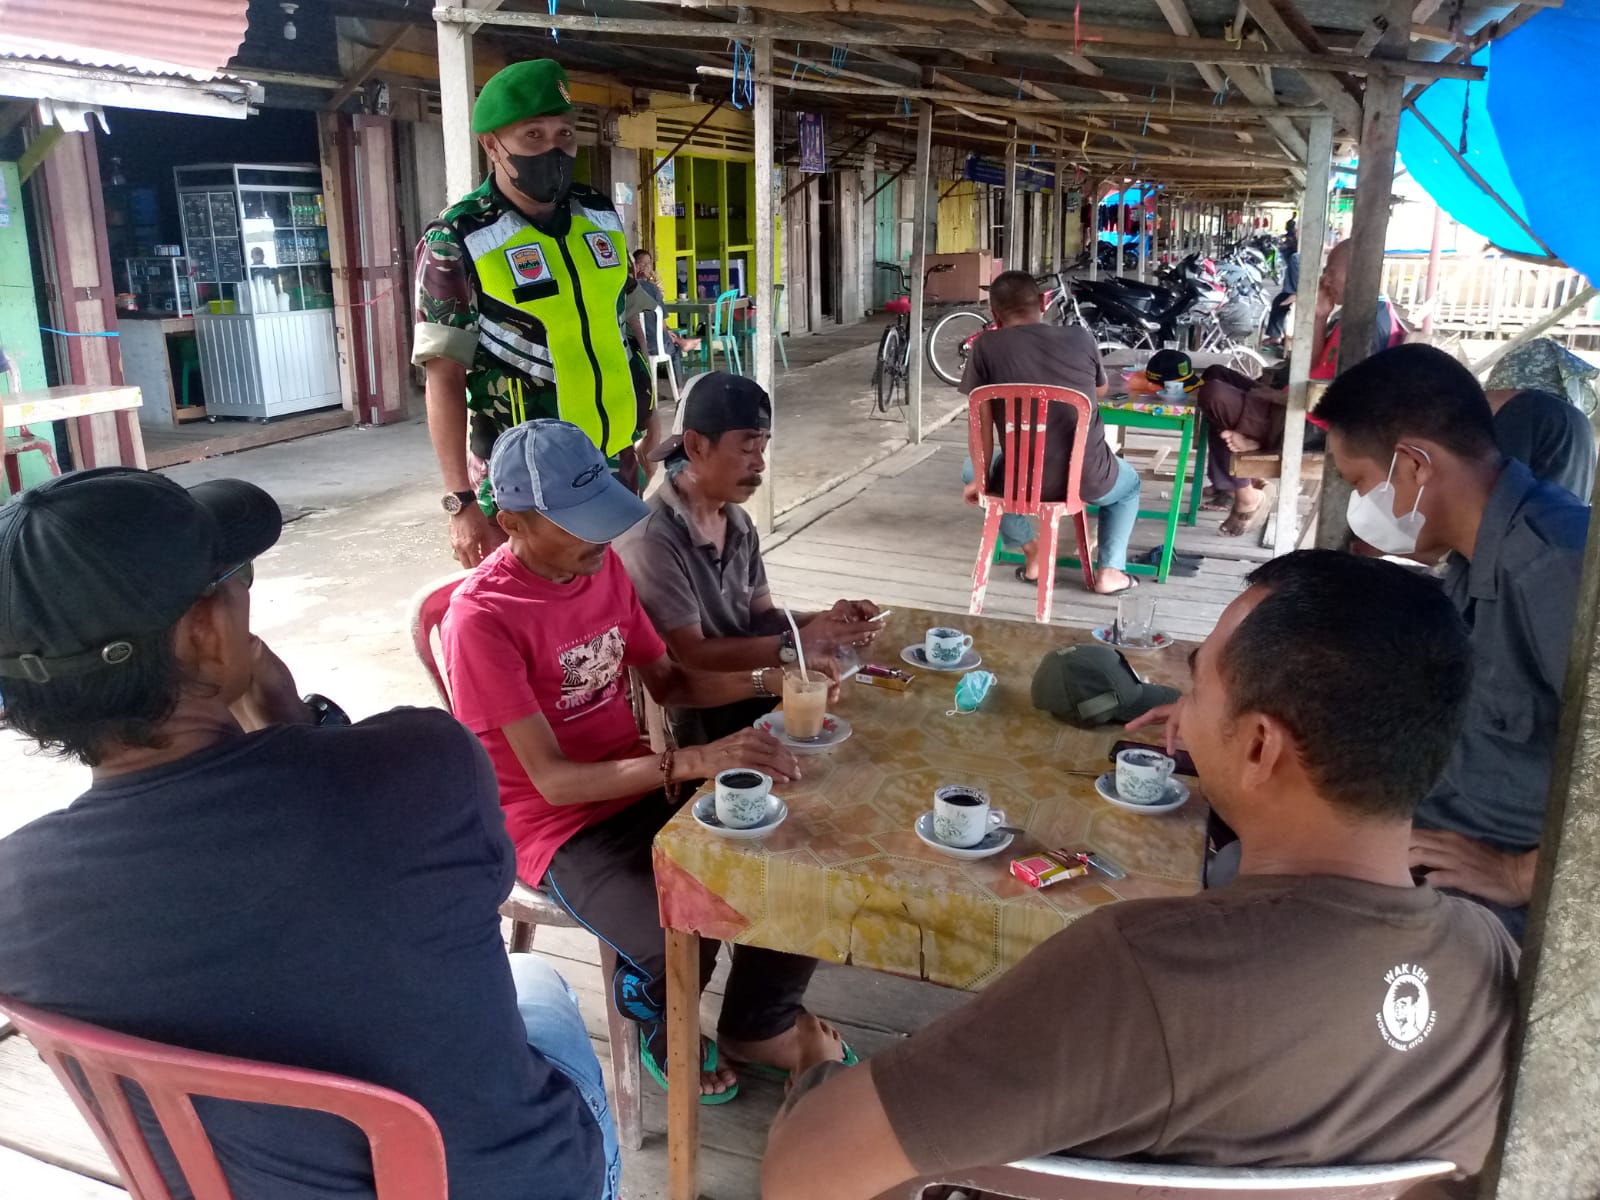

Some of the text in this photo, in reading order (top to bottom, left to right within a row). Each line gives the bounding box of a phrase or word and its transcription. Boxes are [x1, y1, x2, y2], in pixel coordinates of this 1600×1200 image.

[1384, 963, 1429, 984] WAK LEM
[1376, 1012, 1390, 1040] WONG
